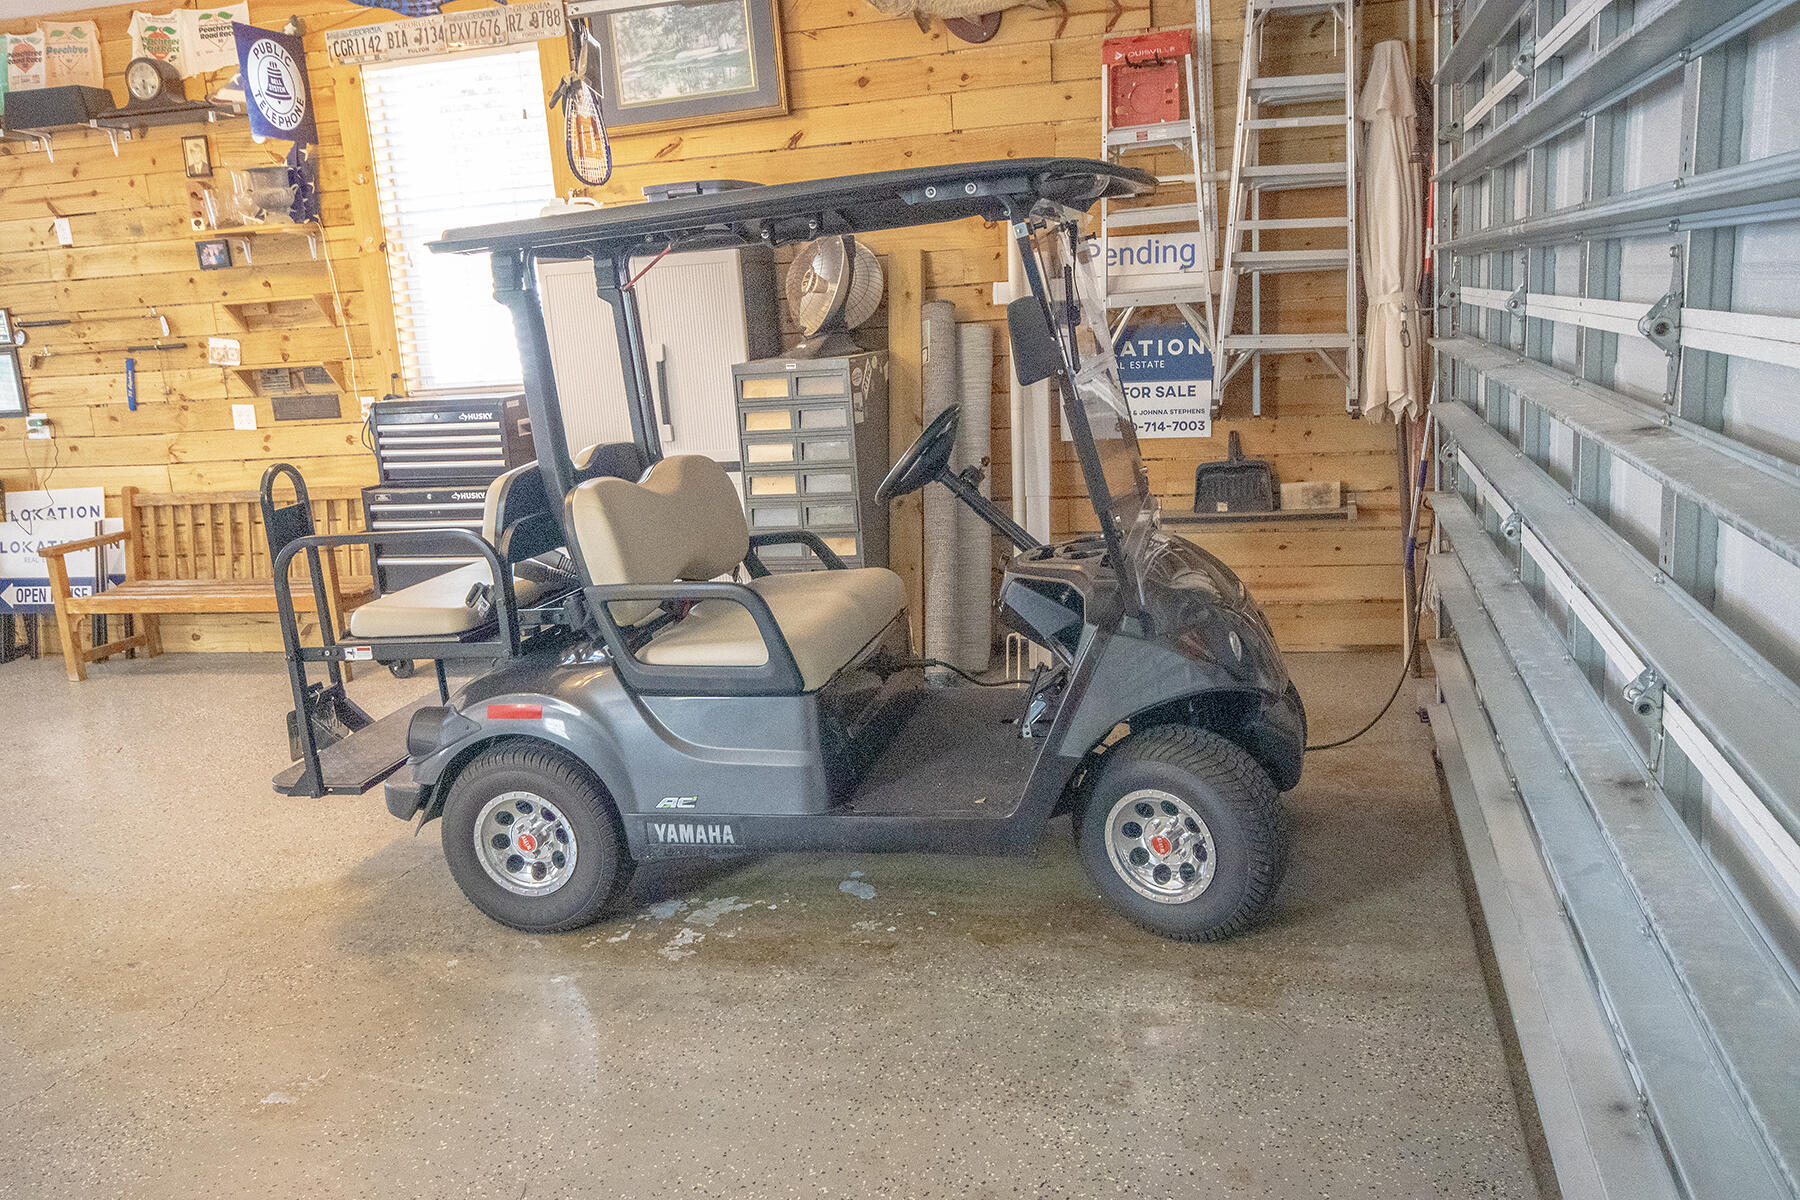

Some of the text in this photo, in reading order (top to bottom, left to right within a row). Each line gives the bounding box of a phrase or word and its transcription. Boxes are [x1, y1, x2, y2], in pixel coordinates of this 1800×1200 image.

[449, 18, 501, 41] PXV7676
[333, 35, 382, 58] CGR1142
[386, 29, 409, 49] BIA
[252, 41, 292, 67] PUBLIC
[254, 89, 305, 128] TELEPHONE
[1088, 239, 1197, 270] Pending
[1116, 338, 1206, 357] ATION
[1129, 360, 1165, 370] ESTATE
[1122, 385, 1197, 399] FOR SALE
[467, 412, 493, 420] HUSKY
[1139, 408, 1169, 416] JOHNNA
[1115, 420, 1206, 433] 80-714-7003
[460, 491, 486, 500] HUSKY
[11, 505, 100, 521] LOKATION
[16, 587, 47, 603] OPEN
[653, 823, 736, 844] YAMAHA
